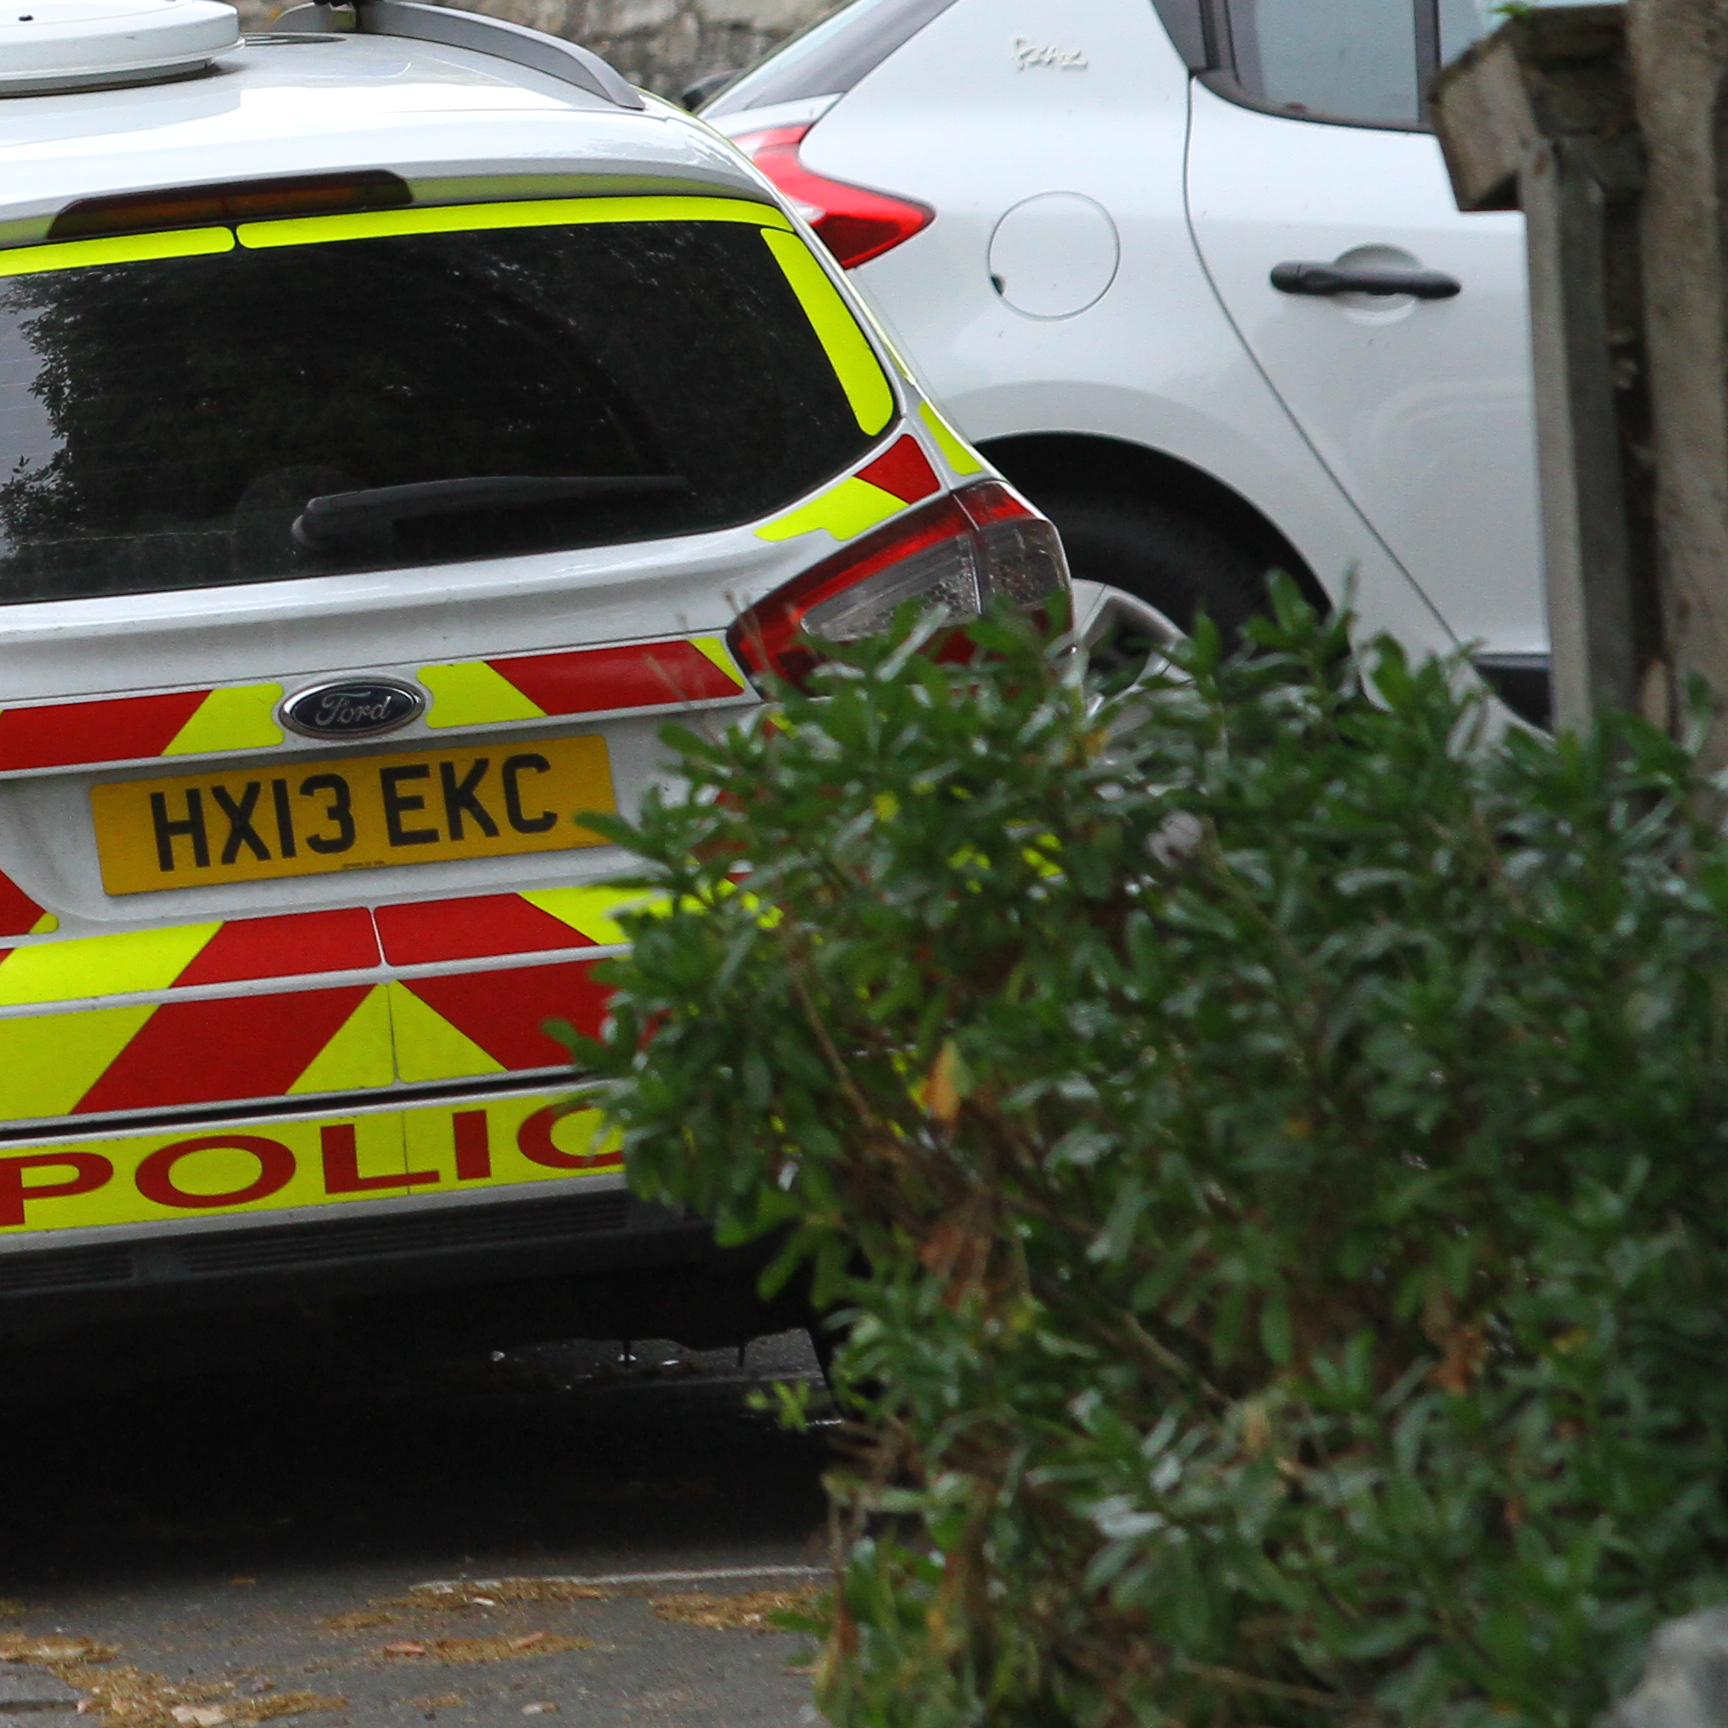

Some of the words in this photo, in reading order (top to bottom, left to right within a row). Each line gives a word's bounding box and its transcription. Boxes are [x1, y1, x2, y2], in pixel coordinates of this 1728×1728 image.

[315, 691, 392, 727] Ford
[149, 772, 356, 873] HX13
[379, 753, 559, 848] EKC
